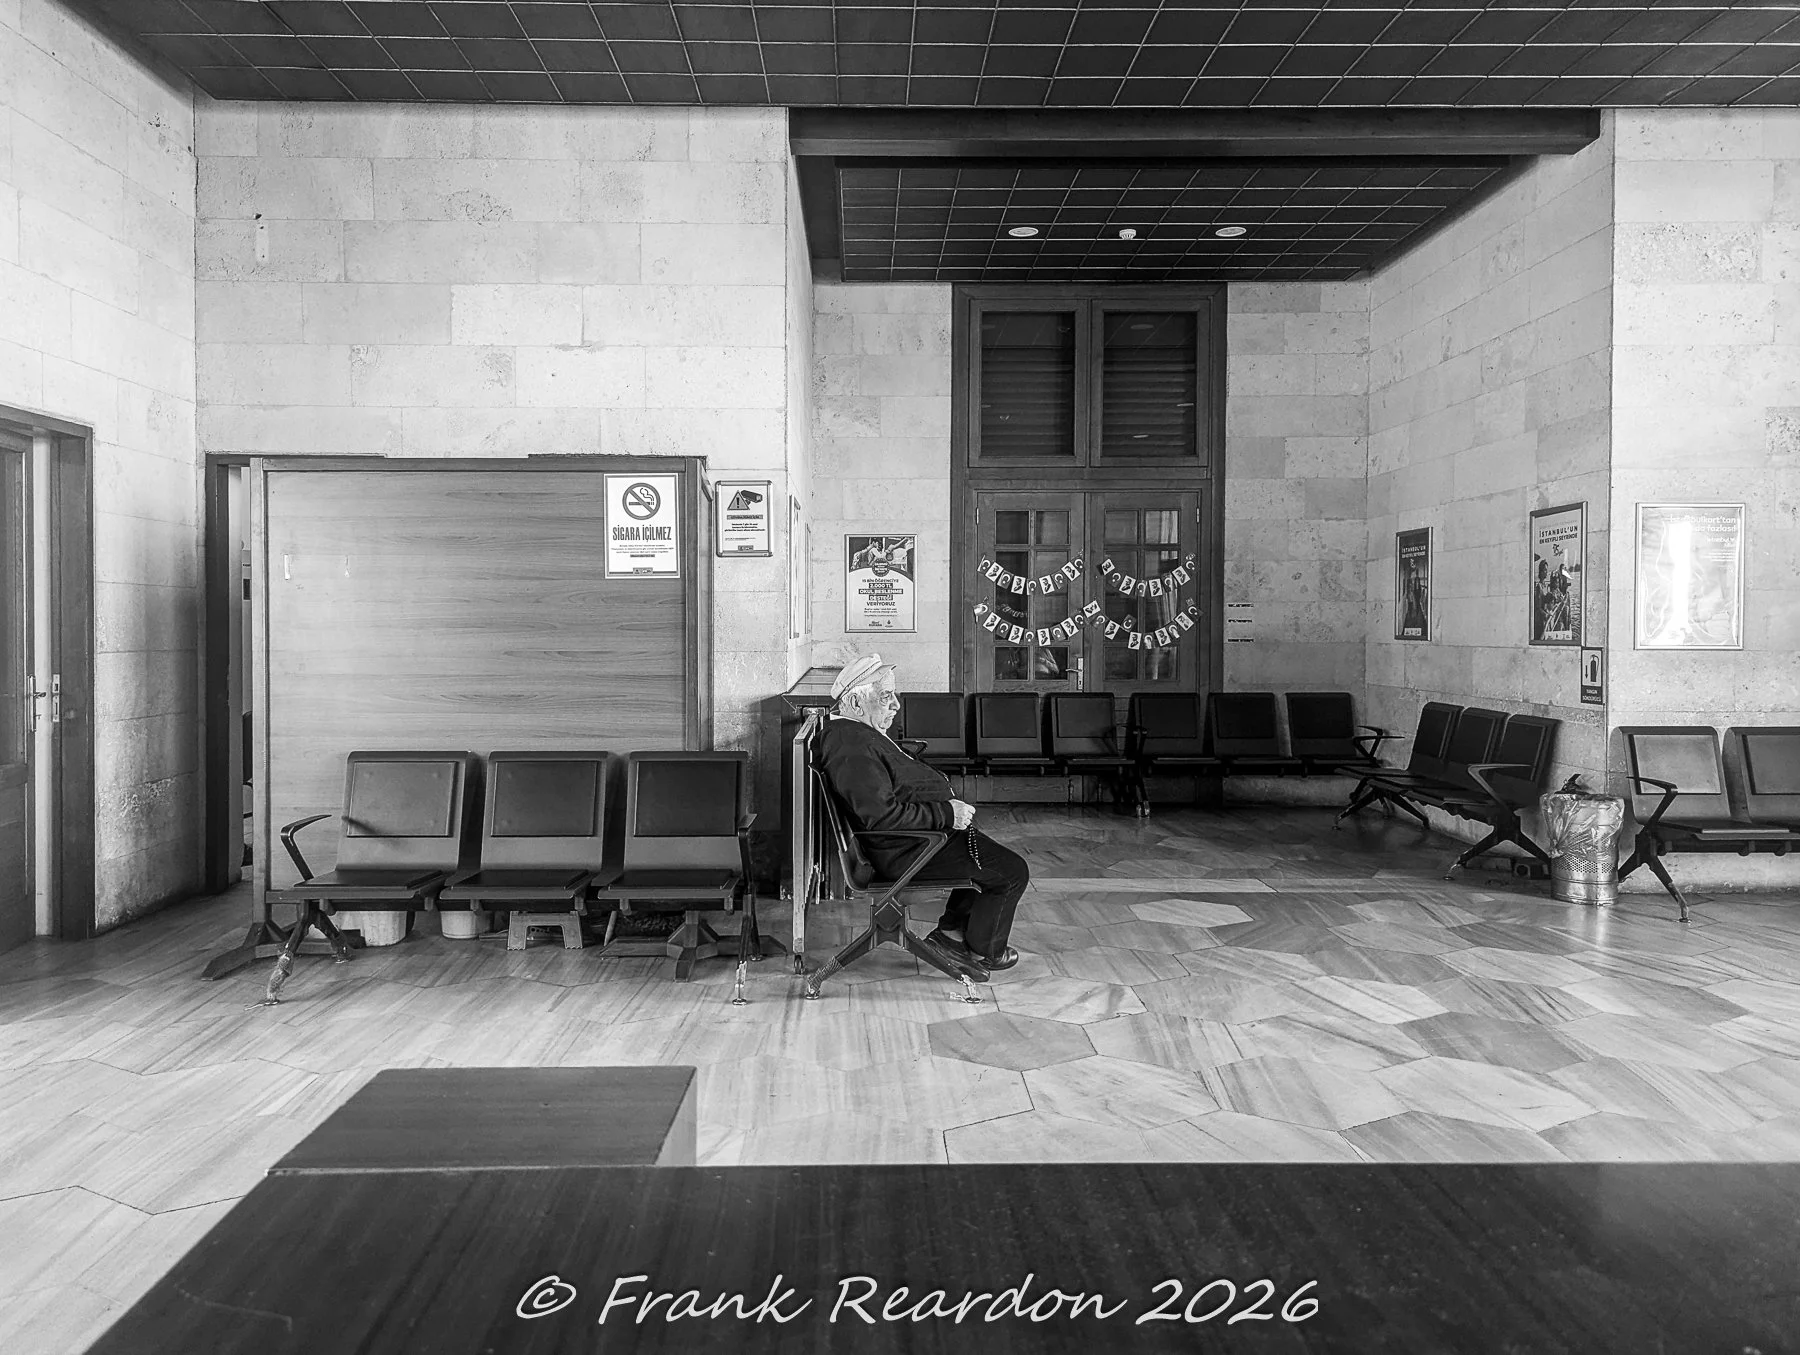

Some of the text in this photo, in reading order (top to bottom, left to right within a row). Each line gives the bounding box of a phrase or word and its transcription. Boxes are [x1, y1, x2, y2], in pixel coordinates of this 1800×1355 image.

[612, 524, 672, 543] SİGARA İÇİLMEZ
[1539, 525, 1578, 538] İSTANBUL'UN
